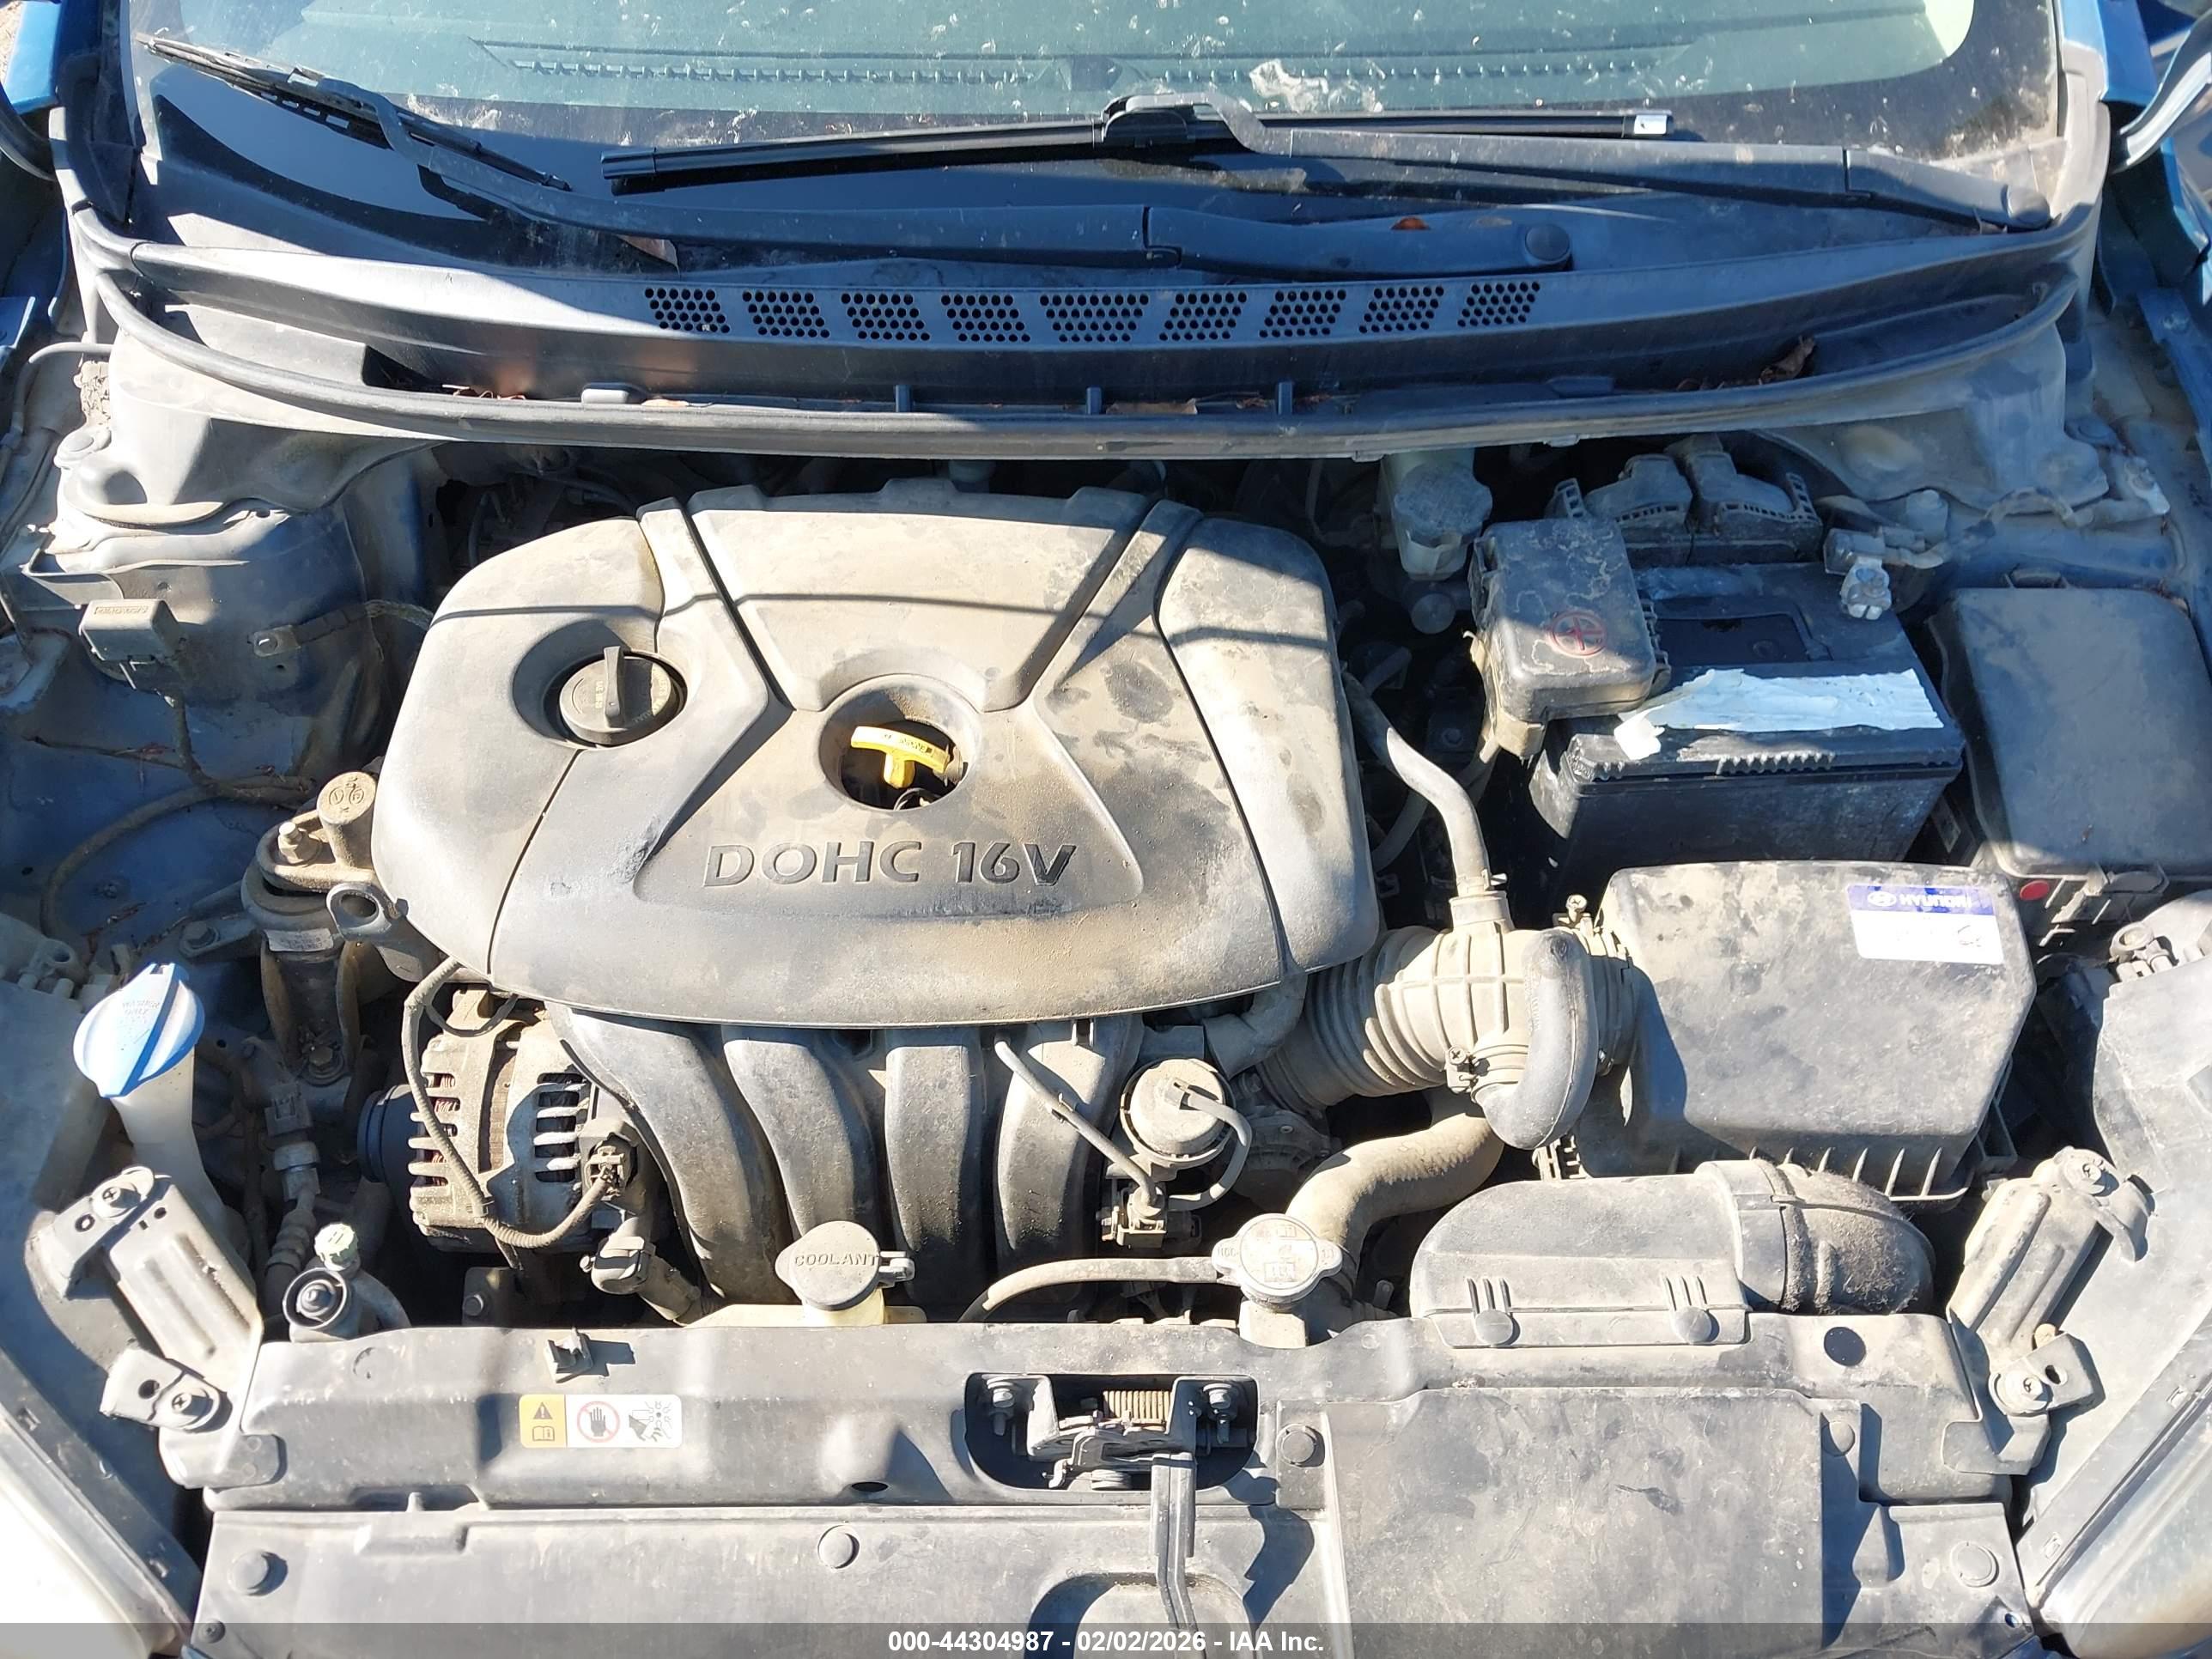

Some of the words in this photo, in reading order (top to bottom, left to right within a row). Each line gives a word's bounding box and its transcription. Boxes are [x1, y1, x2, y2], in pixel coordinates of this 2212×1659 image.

[703, 841, 922, 887] DOHC
[951, 842, 1077, 887] 16V
[1899, 893, 1972, 908] HYUNDAI
[794, 1250, 879, 1267] COOLANT
